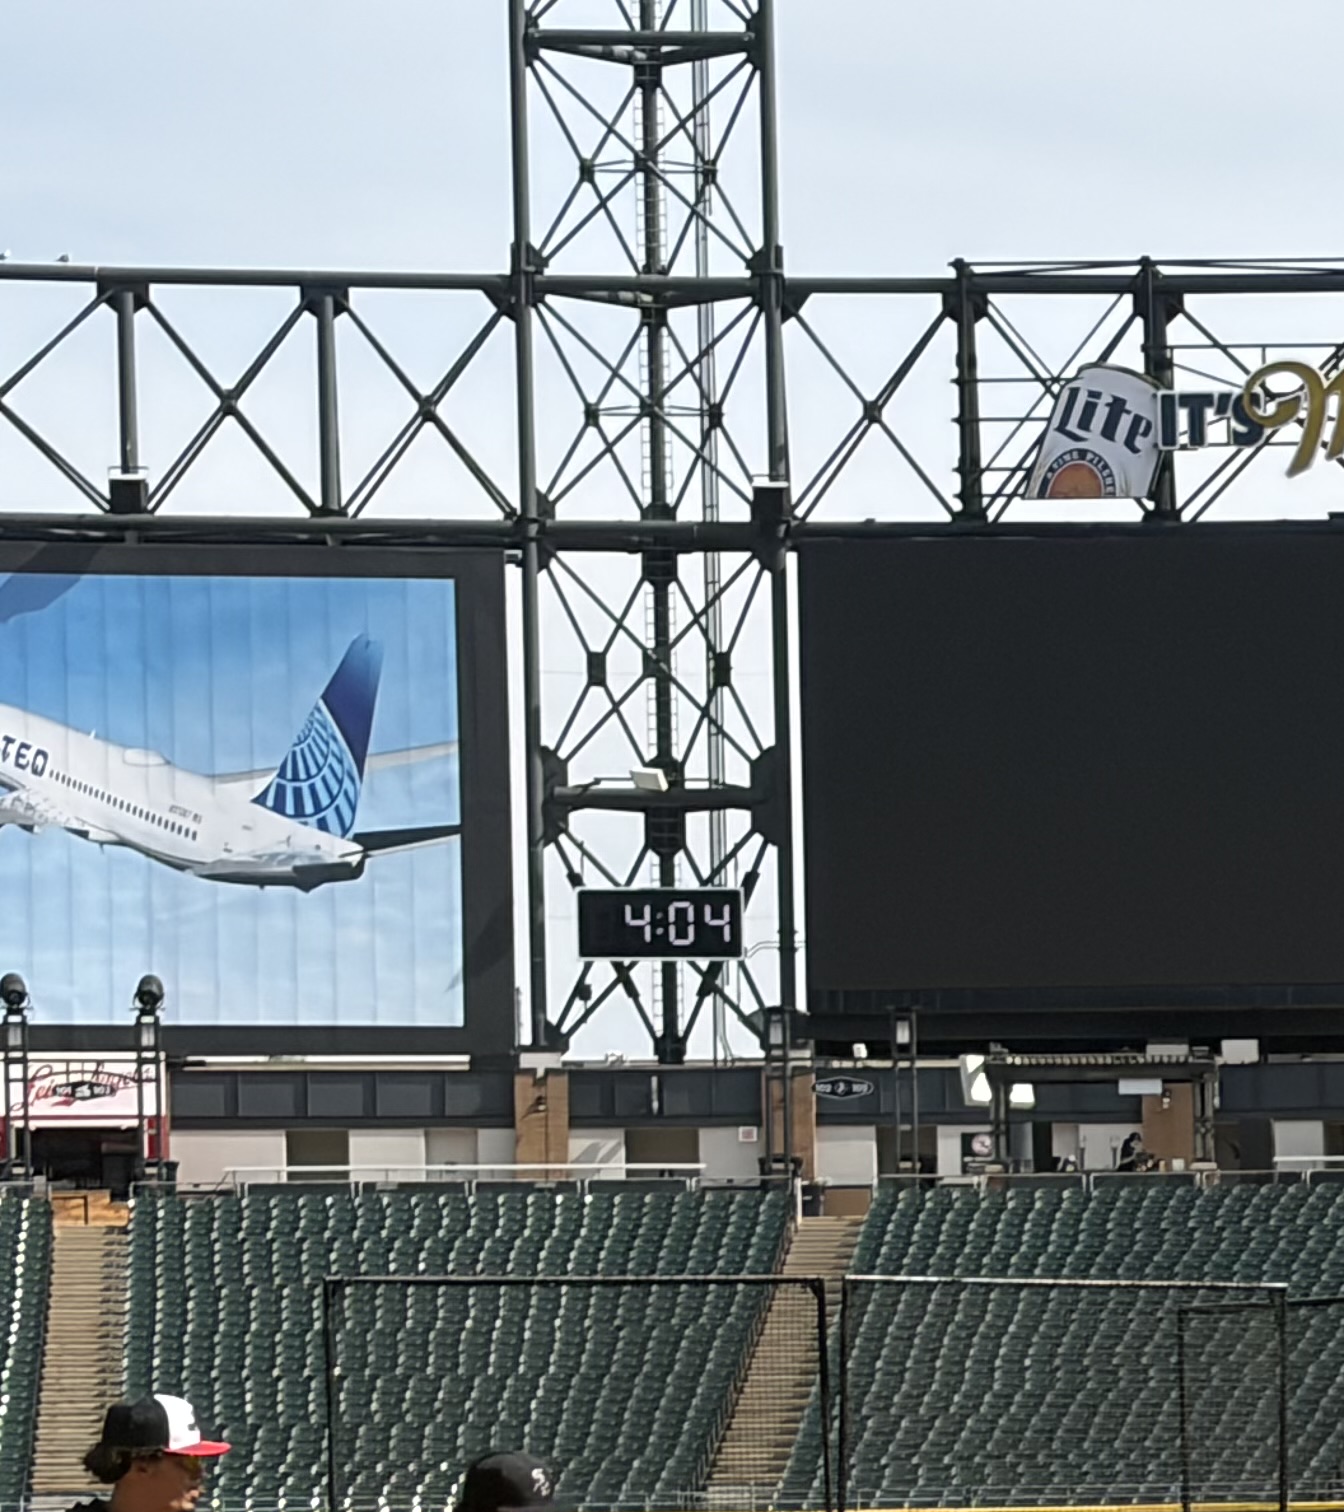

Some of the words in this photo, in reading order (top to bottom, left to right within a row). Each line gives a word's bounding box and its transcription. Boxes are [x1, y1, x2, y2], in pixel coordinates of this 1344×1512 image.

[1054, 386, 1152, 455] Lite
[1157, 390, 1267, 447] IT'S
[625, 901, 731, 946] 4:04
